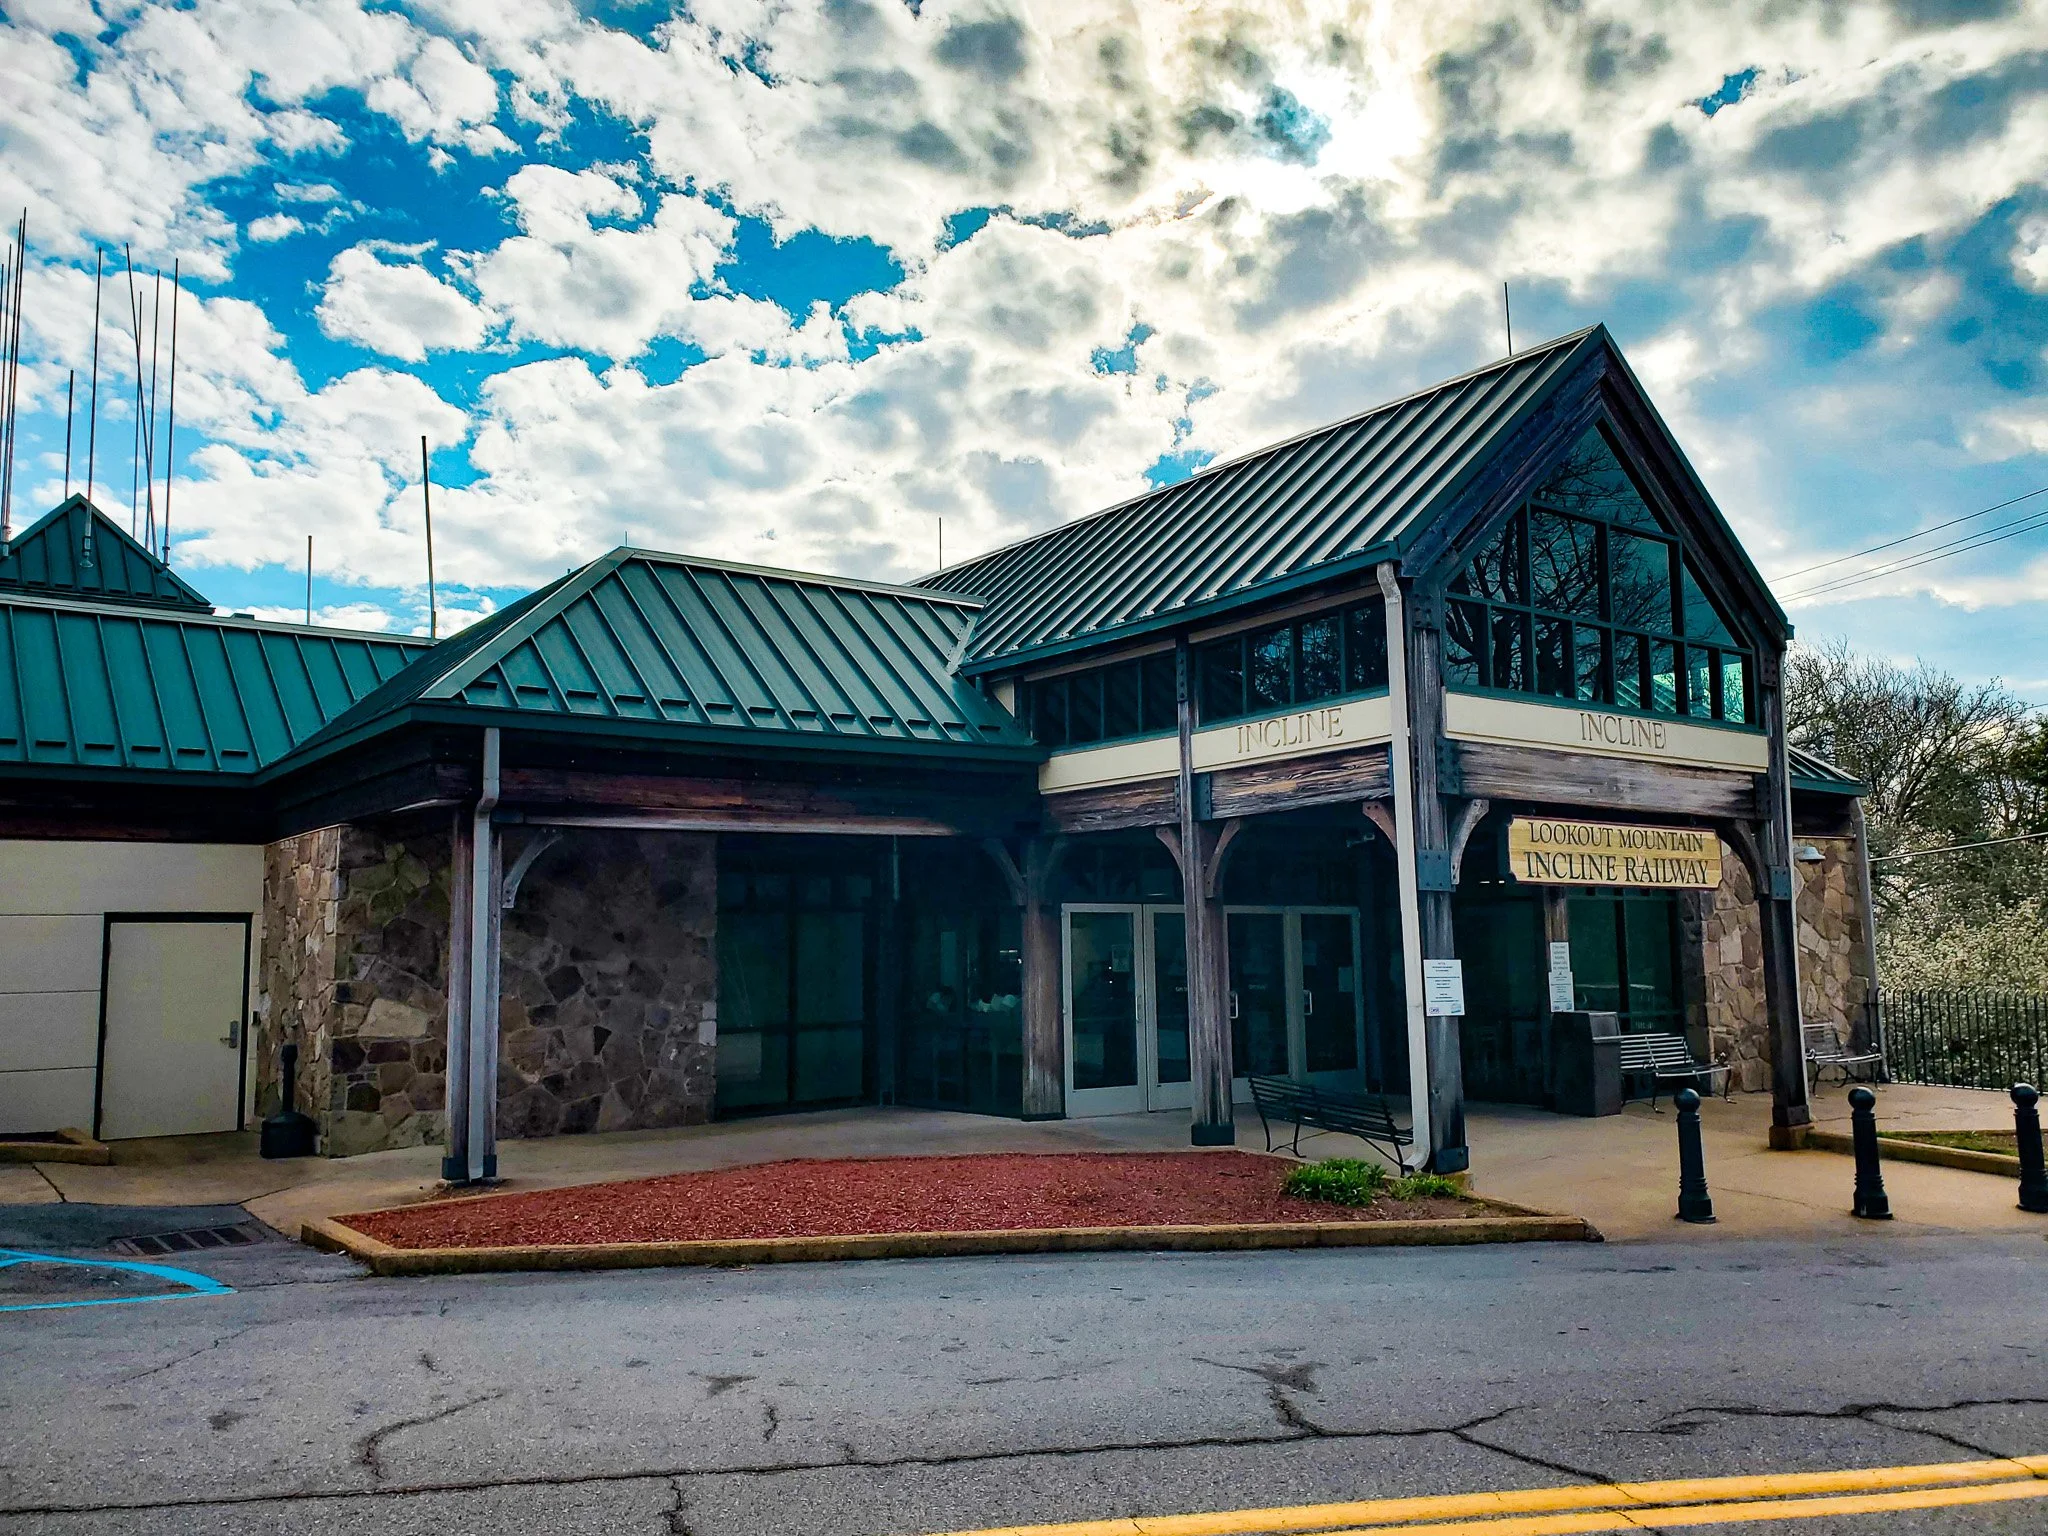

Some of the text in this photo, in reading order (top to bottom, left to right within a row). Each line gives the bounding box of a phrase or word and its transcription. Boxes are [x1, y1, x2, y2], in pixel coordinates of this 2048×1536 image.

[1237, 707, 1343, 753] INCLINE
[1580, 712, 1665, 749] INCLINE
[1528, 821, 1703, 852] LOOKOUT MOUNTAIN
[1524, 851, 1709, 885] INCLINE RAILWAY
